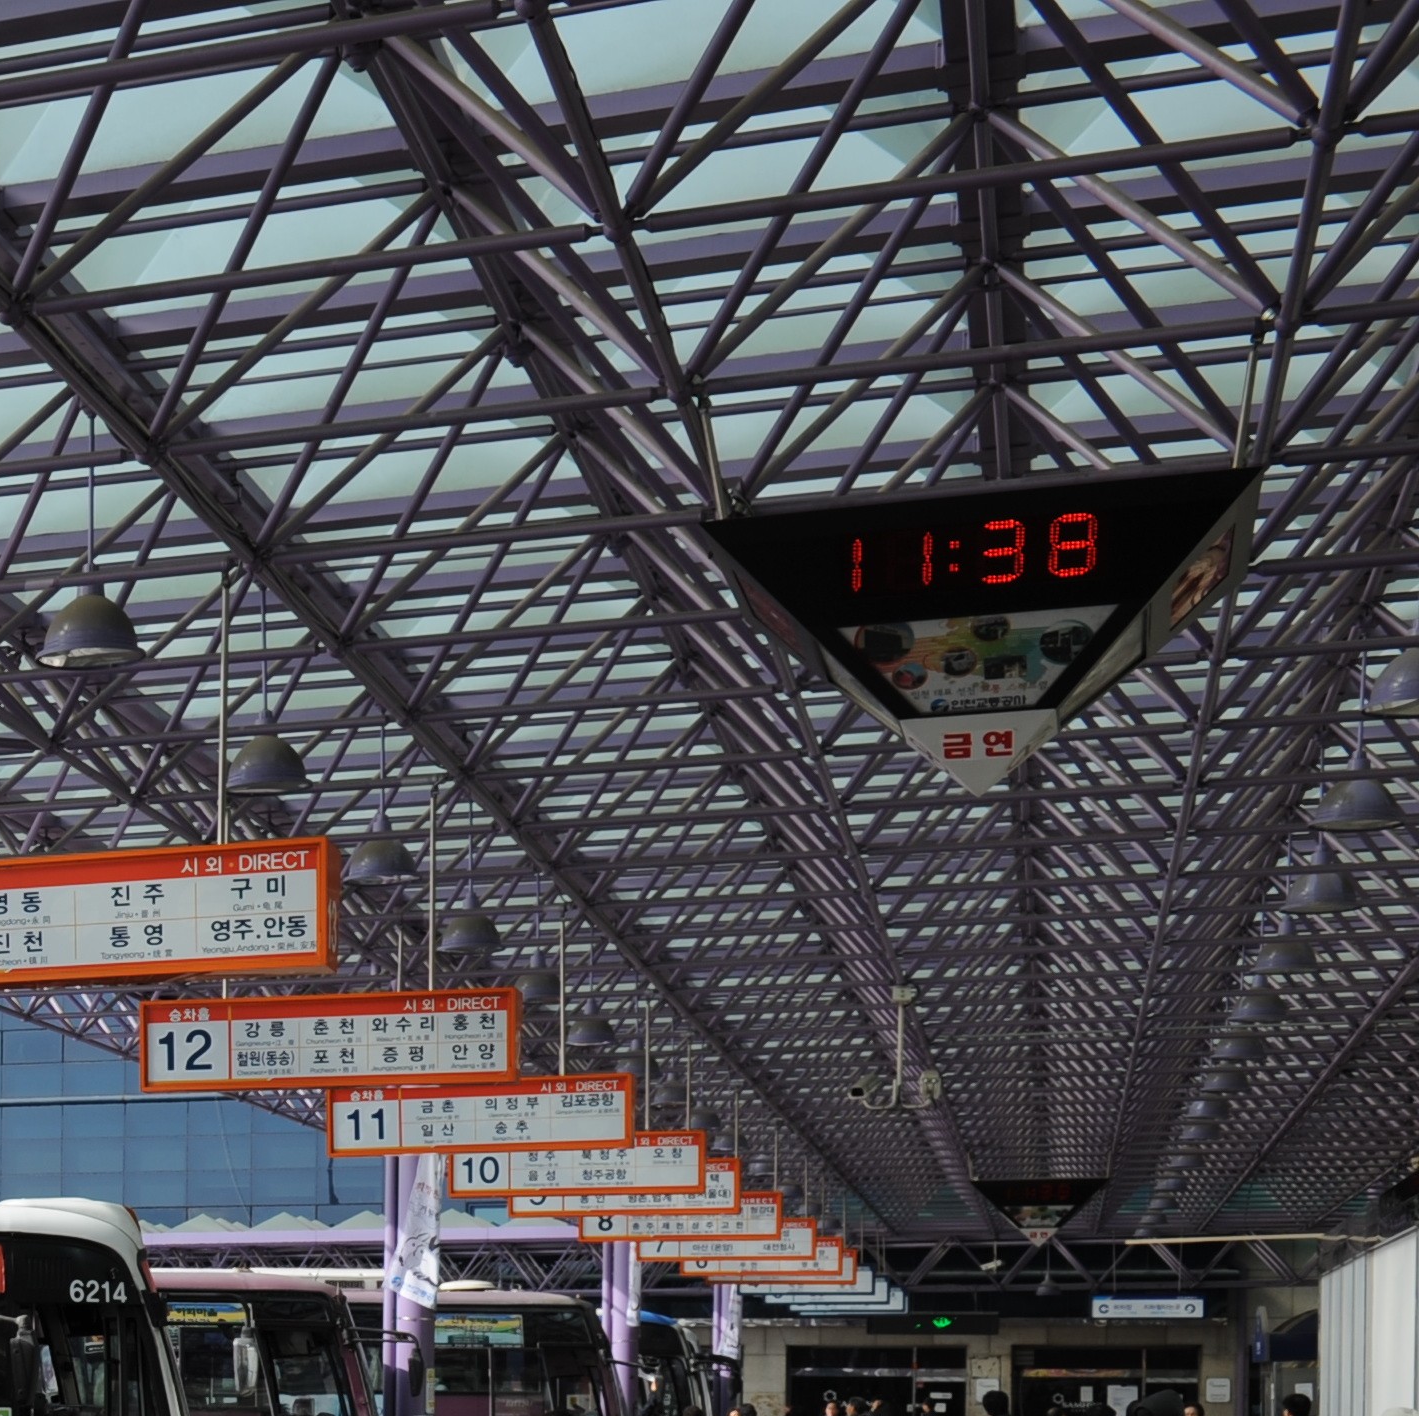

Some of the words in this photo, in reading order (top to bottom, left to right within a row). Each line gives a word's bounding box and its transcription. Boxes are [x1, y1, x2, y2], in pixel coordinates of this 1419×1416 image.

[850, 511, 1099, 593] 11:38
[943, 730, 1013, 760] 금연
[180, 856, 223, 876] 시외
[238, 851, 309, 872] DIRECT
[111, 883, 165, 907] 진주
[230, 875, 286, 899] 구미
[232, 903, 255, 912] Gumi
[109, 923, 164, 949] 통영
[211, 915, 308, 942] 영주.안동
[403, 999, 435, 1013] 시외
[446, 996, 501, 1011] DIRECT
[168, 1007, 211, 1022] 승차홈
[452, 1013, 495, 1031] 홍천
[245, 1021, 286, 1038] 강릉
[313, 1018, 355, 1035] 춘천
[371, 1015, 435, 1033] 와수리
[158, 1029, 213, 1071] 12
[313, 1047, 355, 1064] 포천
[382, 1045, 424, 1063] 증평
[451, 1043, 495, 1061] 안양
[575, 1080, 619, 1092] DIRECT
[485, 1097, 539, 1111] 의정부
[561, 1093, 615, 1107] 김포공항
[347, 1108, 385, 1141] 11
[421, 1123, 454, 1137] 일산
[657, 1136, 694, 1146] DIRECT
[462, 1156, 500, 1184] 10
[69, 1279, 128, 1303] 6214
